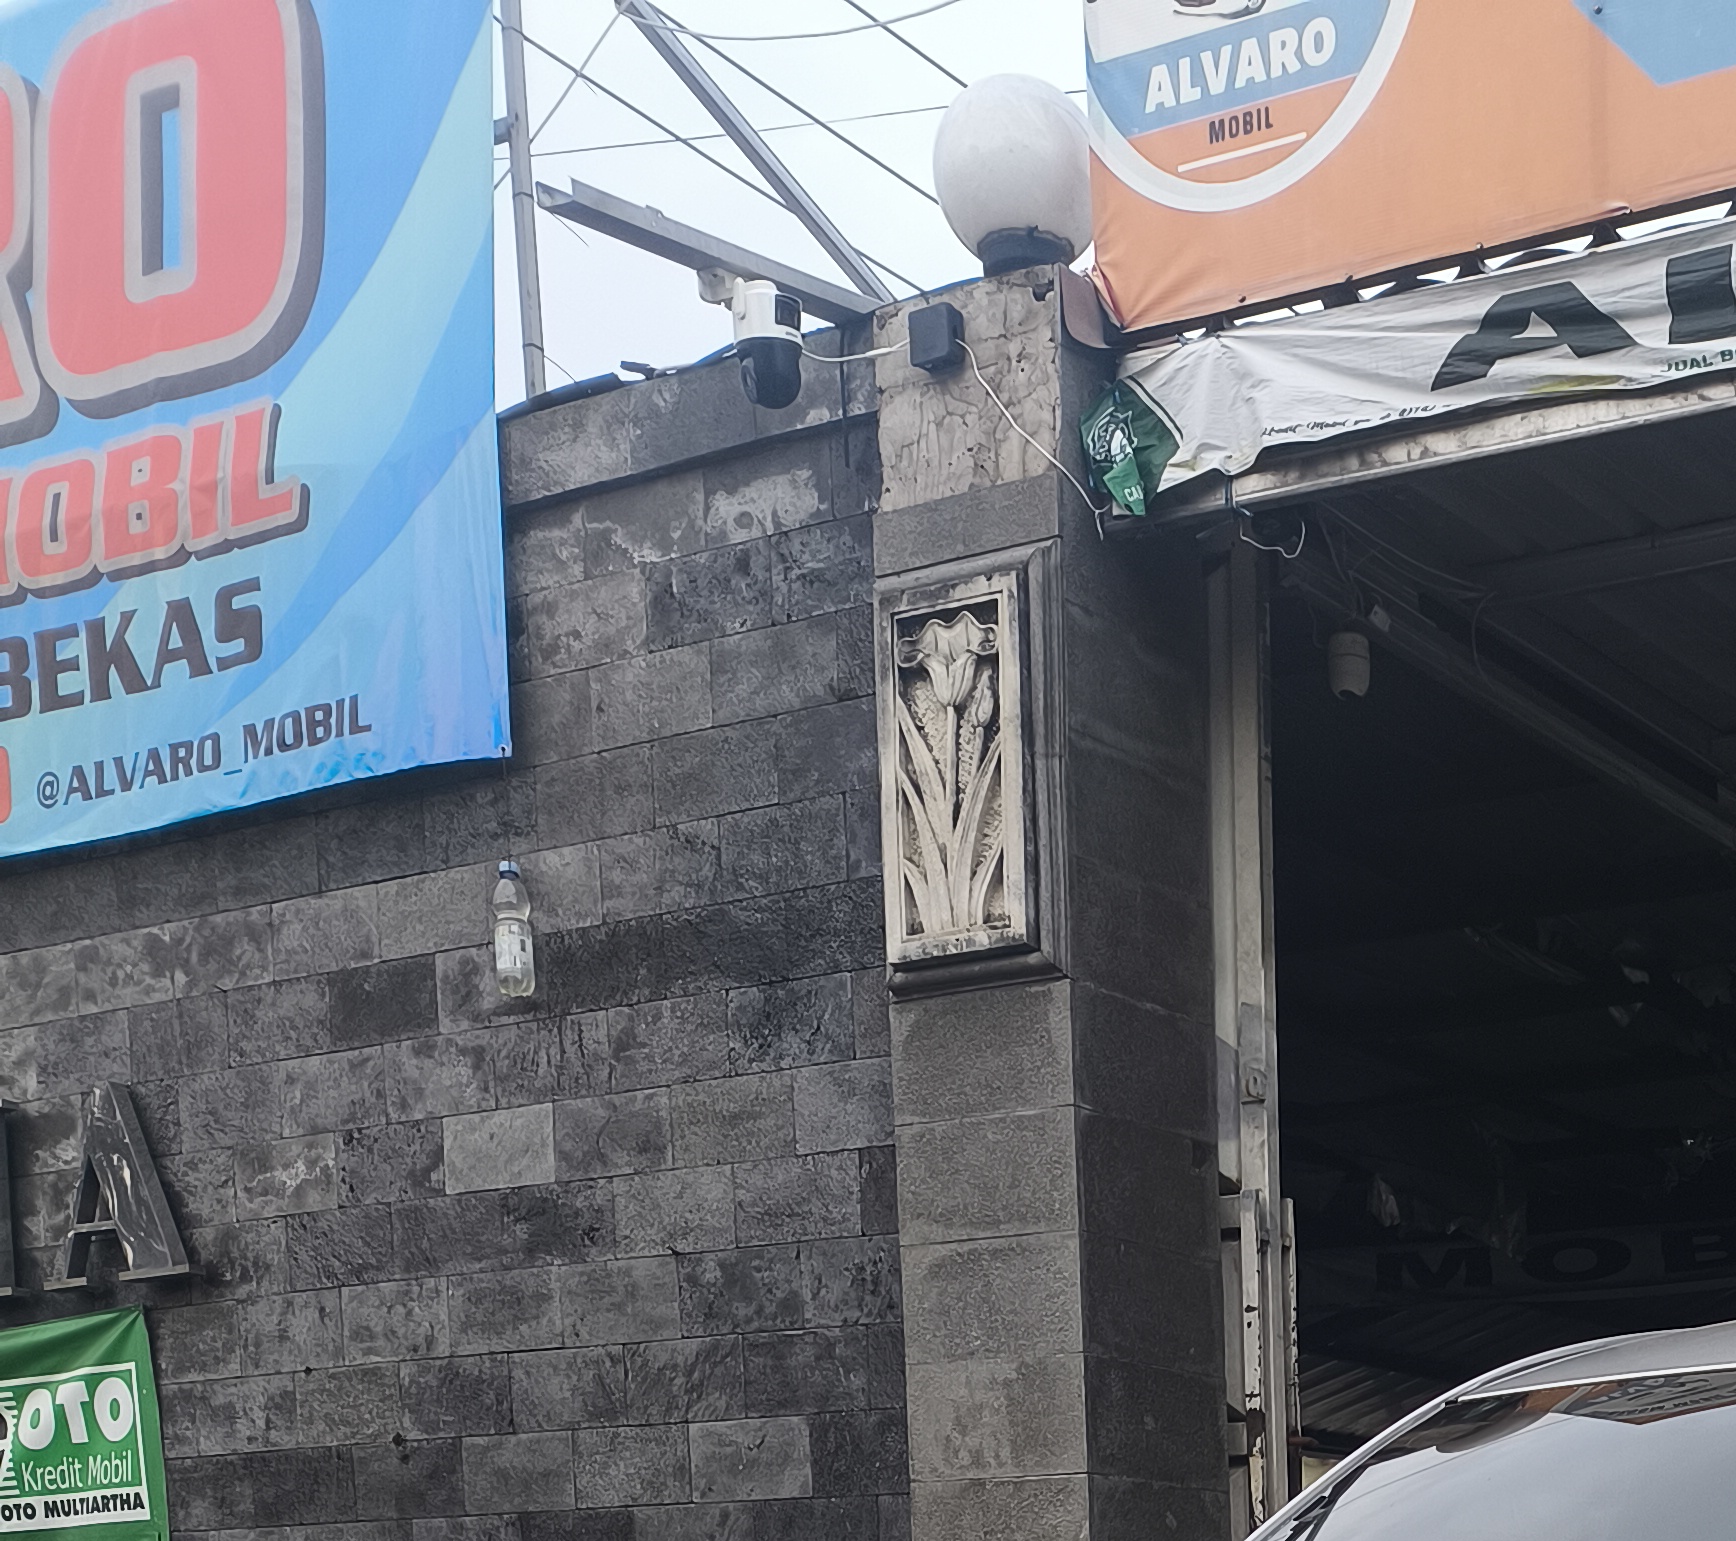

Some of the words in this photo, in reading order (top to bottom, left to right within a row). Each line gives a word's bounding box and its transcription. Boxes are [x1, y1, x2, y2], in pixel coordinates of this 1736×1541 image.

[1145, 16, 1337, 114] ALVARO
[1208, 106, 1274, 145] MOBIL
[1660, 354, 1714, 373] JUAL
[0, 403, 310, 608] OBIL
[0, 576, 263, 722] BEKAS
[37, 694, 372, 809] @ALVARO_MOBIL
[0, 1081, 189, 1296] A
[18, 1377, 134, 1450] OTO
[0, 1502, 37, 1522] OTO
[44, 1492, 146, 1519] MULTIARTHA
[21, 1456, 83, 1492] Kredit
[88, 1449, 132, 1486] Mobil
